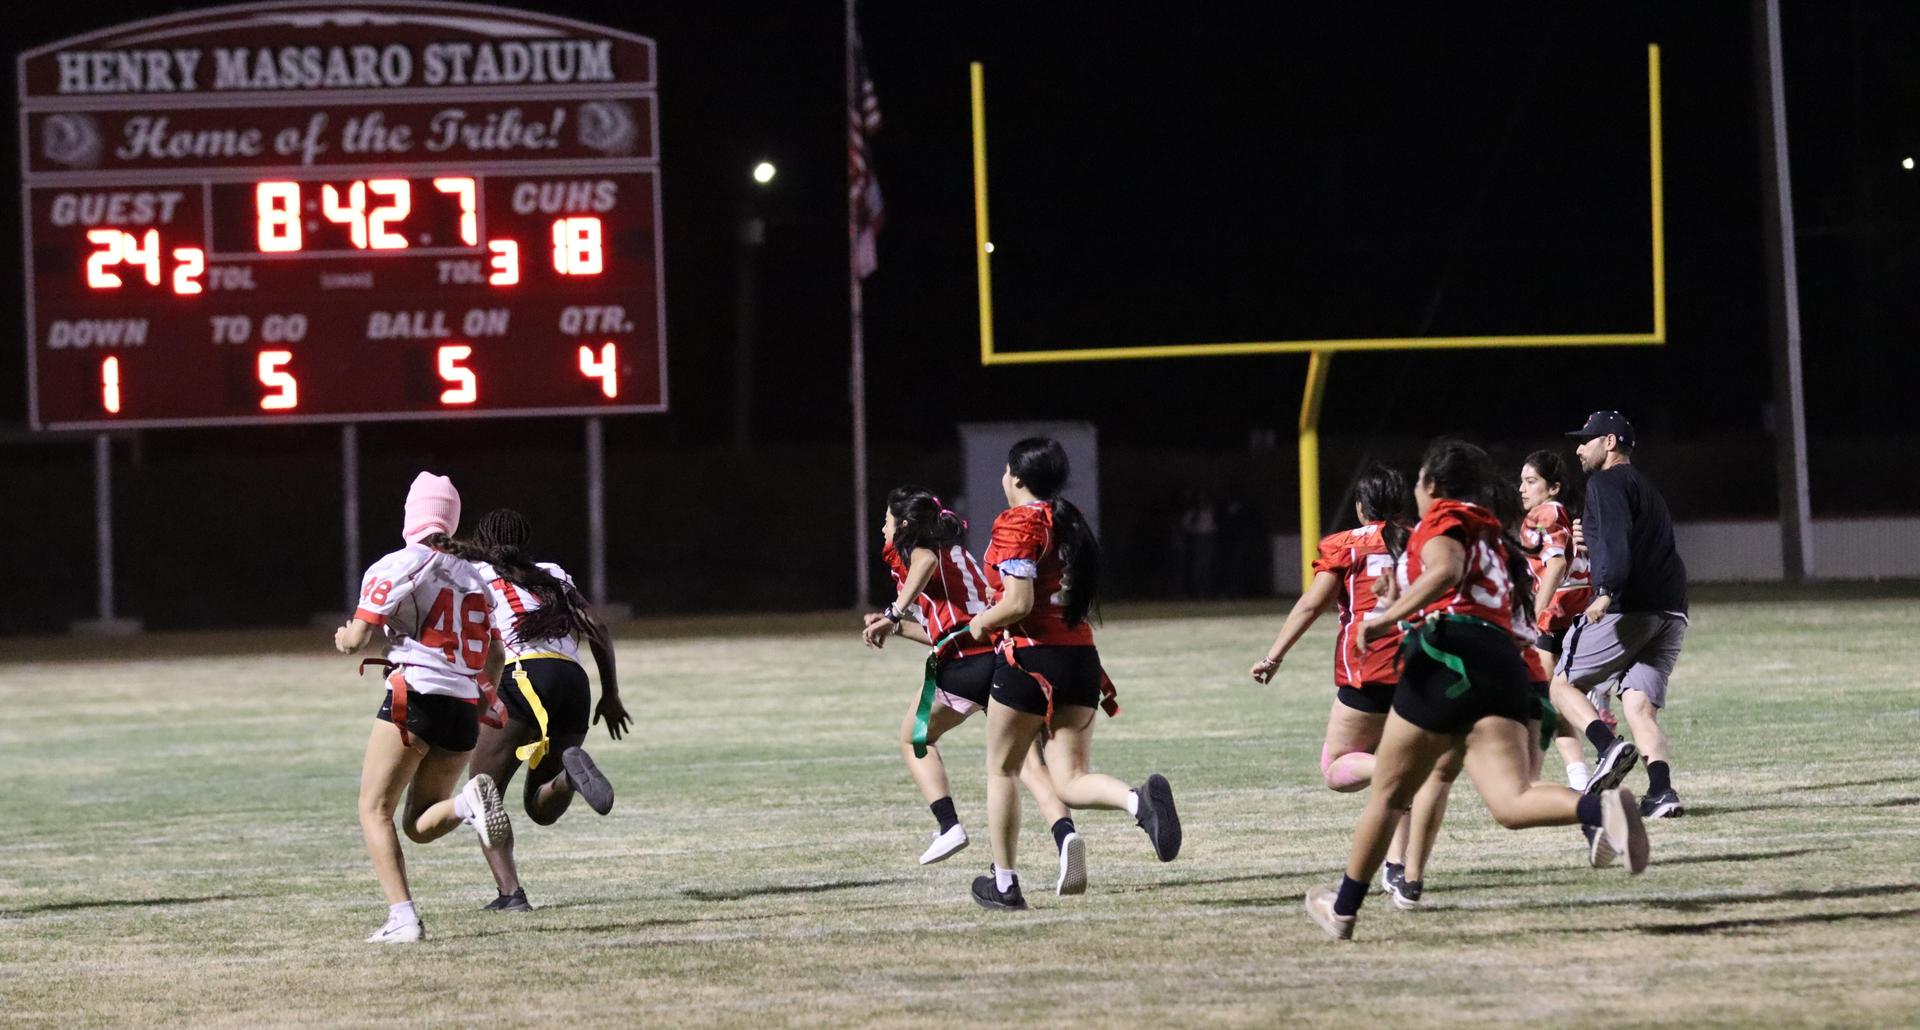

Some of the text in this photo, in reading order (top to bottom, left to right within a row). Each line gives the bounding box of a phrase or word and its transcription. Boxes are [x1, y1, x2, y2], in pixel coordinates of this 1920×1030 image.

[57, 39, 615, 94] HENRY MASSARO STADIUM
[115, 107, 566, 166] Home of the Tribe!
[51, 191, 183, 227] GUEST
[512, 179, 618, 215] CUHS
[86, 228, 160, 289] 24
[488, 239, 519, 286] 3
[552, 216, 603, 275] 18
[172, 247, 204, 295] 2
[208, 265, 257, 291] TOL
[436, 259, 485, 285] TOL
[48, 318, 149, 349] DOWN
[210, 312, 308, 345] TO GO
[366, 307, 511, 340] BALL ON
[559, 304, 635, 337] QTR.
[102, 356, 120, 413] 1
[258, 350, 298, 410] 5
[437, 345, 477, 404] 5
[579, 342, 617, 398] 4
[362, 576, 392, 606] 48
[420, 587, 491, 671] 48
